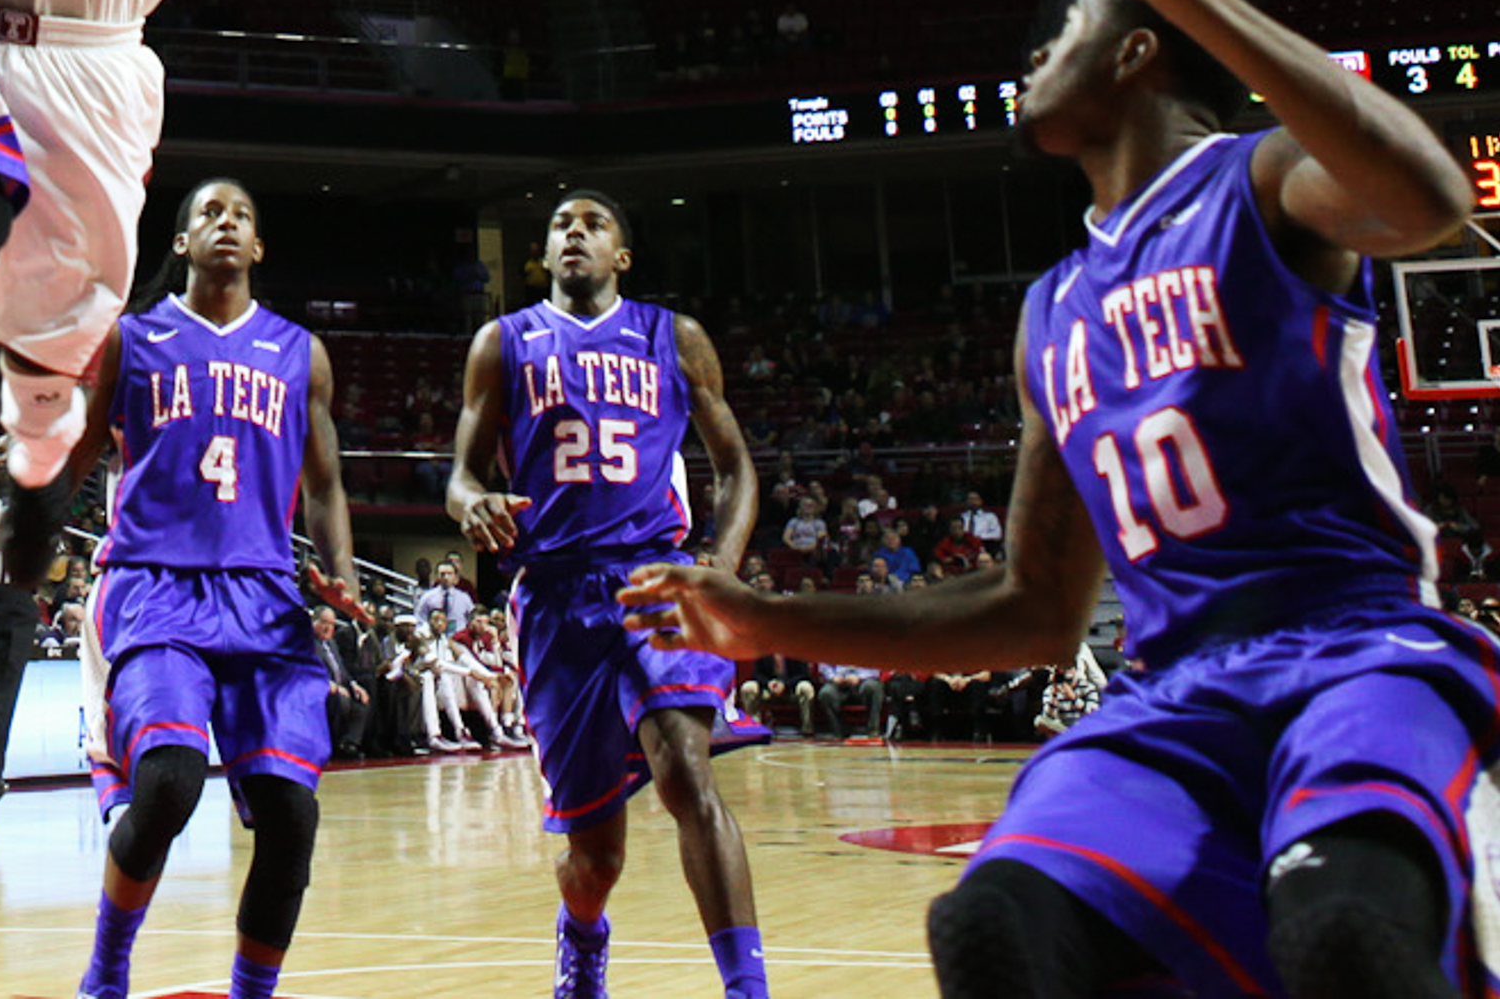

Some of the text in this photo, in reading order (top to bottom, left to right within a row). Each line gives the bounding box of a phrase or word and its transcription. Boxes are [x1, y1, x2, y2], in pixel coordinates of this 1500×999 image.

[1388, 46, 1441, 66] FOULS
[1448, 44, 1481, 60] TOL
[1406, 61, 1480, 94] 3 4
[792, 97, 1017, 128] POINTS 0 0 4 3
[792, 124, 845, 143] FOULS
[965, 113, 975, 130] 1
[1006, 111, 1016, 127] 1
[523, 350, 662, 420] LA TECH
[1042, 265, 1246, 448] LA TECH
[150, 359, 288, 440] LA TECH
[199, 434, 238, 503] 4
[553, 418, 640, 485] 25
[1093, 405, 1232, 564] 10
